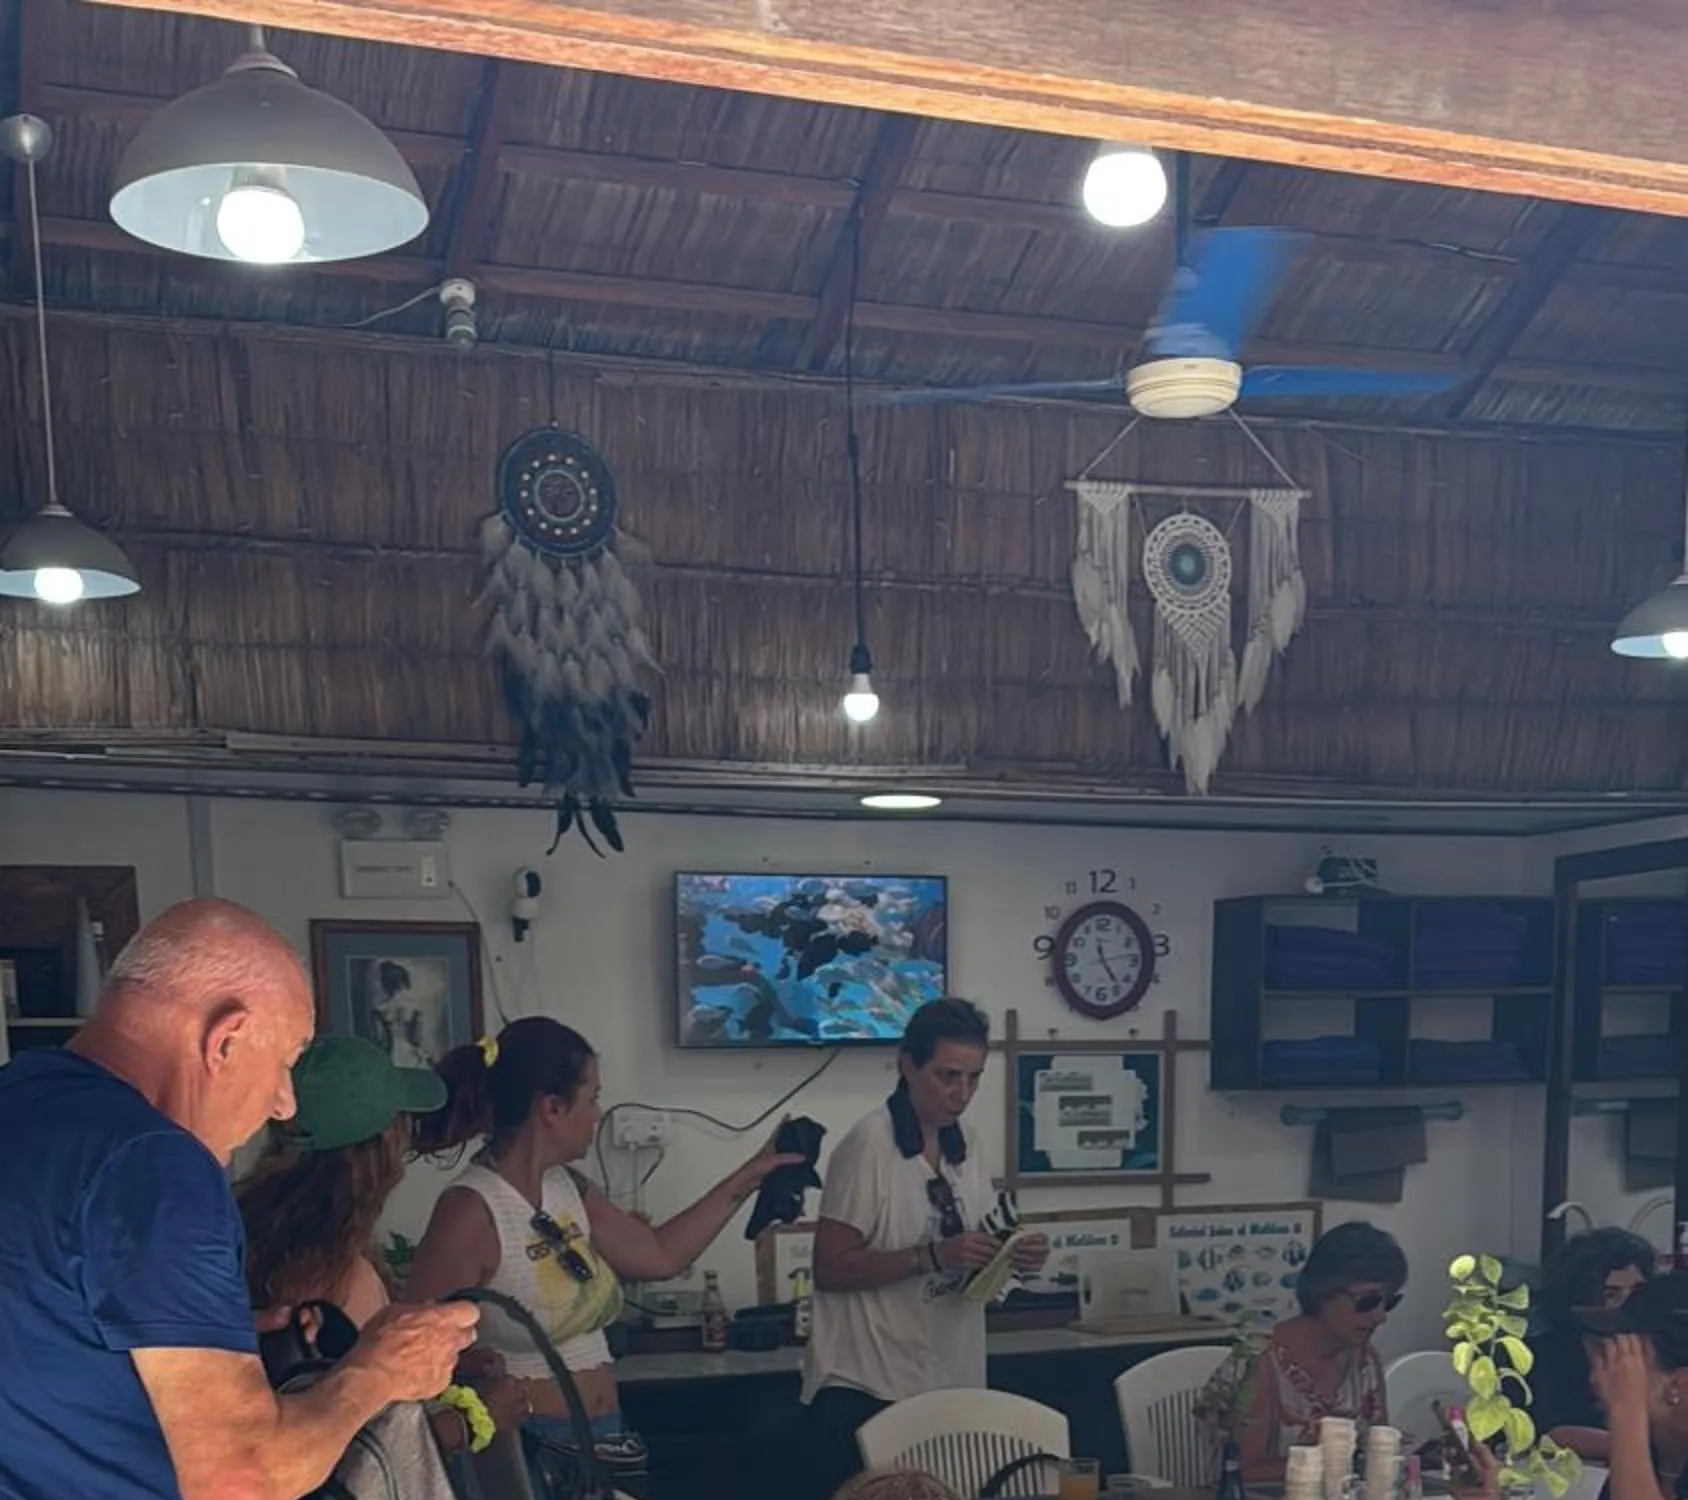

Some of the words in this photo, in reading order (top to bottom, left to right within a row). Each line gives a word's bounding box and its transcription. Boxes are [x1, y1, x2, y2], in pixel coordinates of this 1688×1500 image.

[1065, 880, 1077, 895] 11
[1089, 869, 1118, 894] 12
[1129, 876, 1136, 890] 1
[1044, 905, 1060, 920] 10
[1151, 903, 1162, 915] 2
[1095, 917, 1112, 932] 12
[1033, 935, 1055, 960] 9
[1153, 934, 1170, 957] 3
[1095, 987, 1108, 1001] 6
